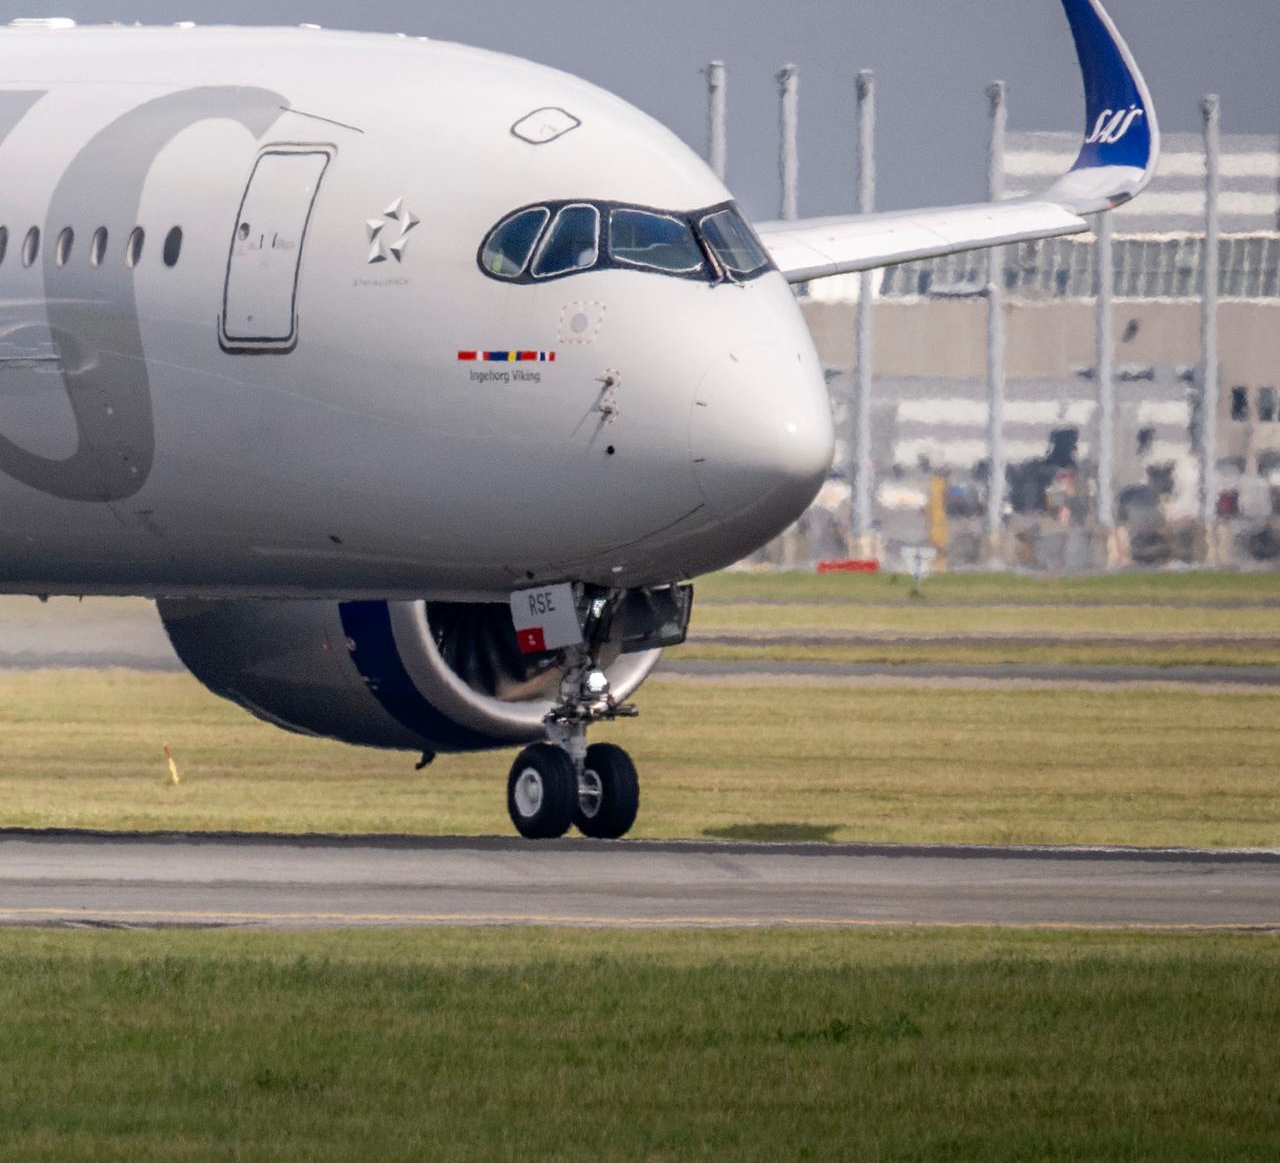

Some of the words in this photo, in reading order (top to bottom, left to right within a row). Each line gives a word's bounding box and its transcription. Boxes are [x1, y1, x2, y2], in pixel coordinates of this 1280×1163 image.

[469, 369, 509, 384] Ingeborg
[512, 369, 541, 383] Viking
[528, 592, 556, 616] RSE
